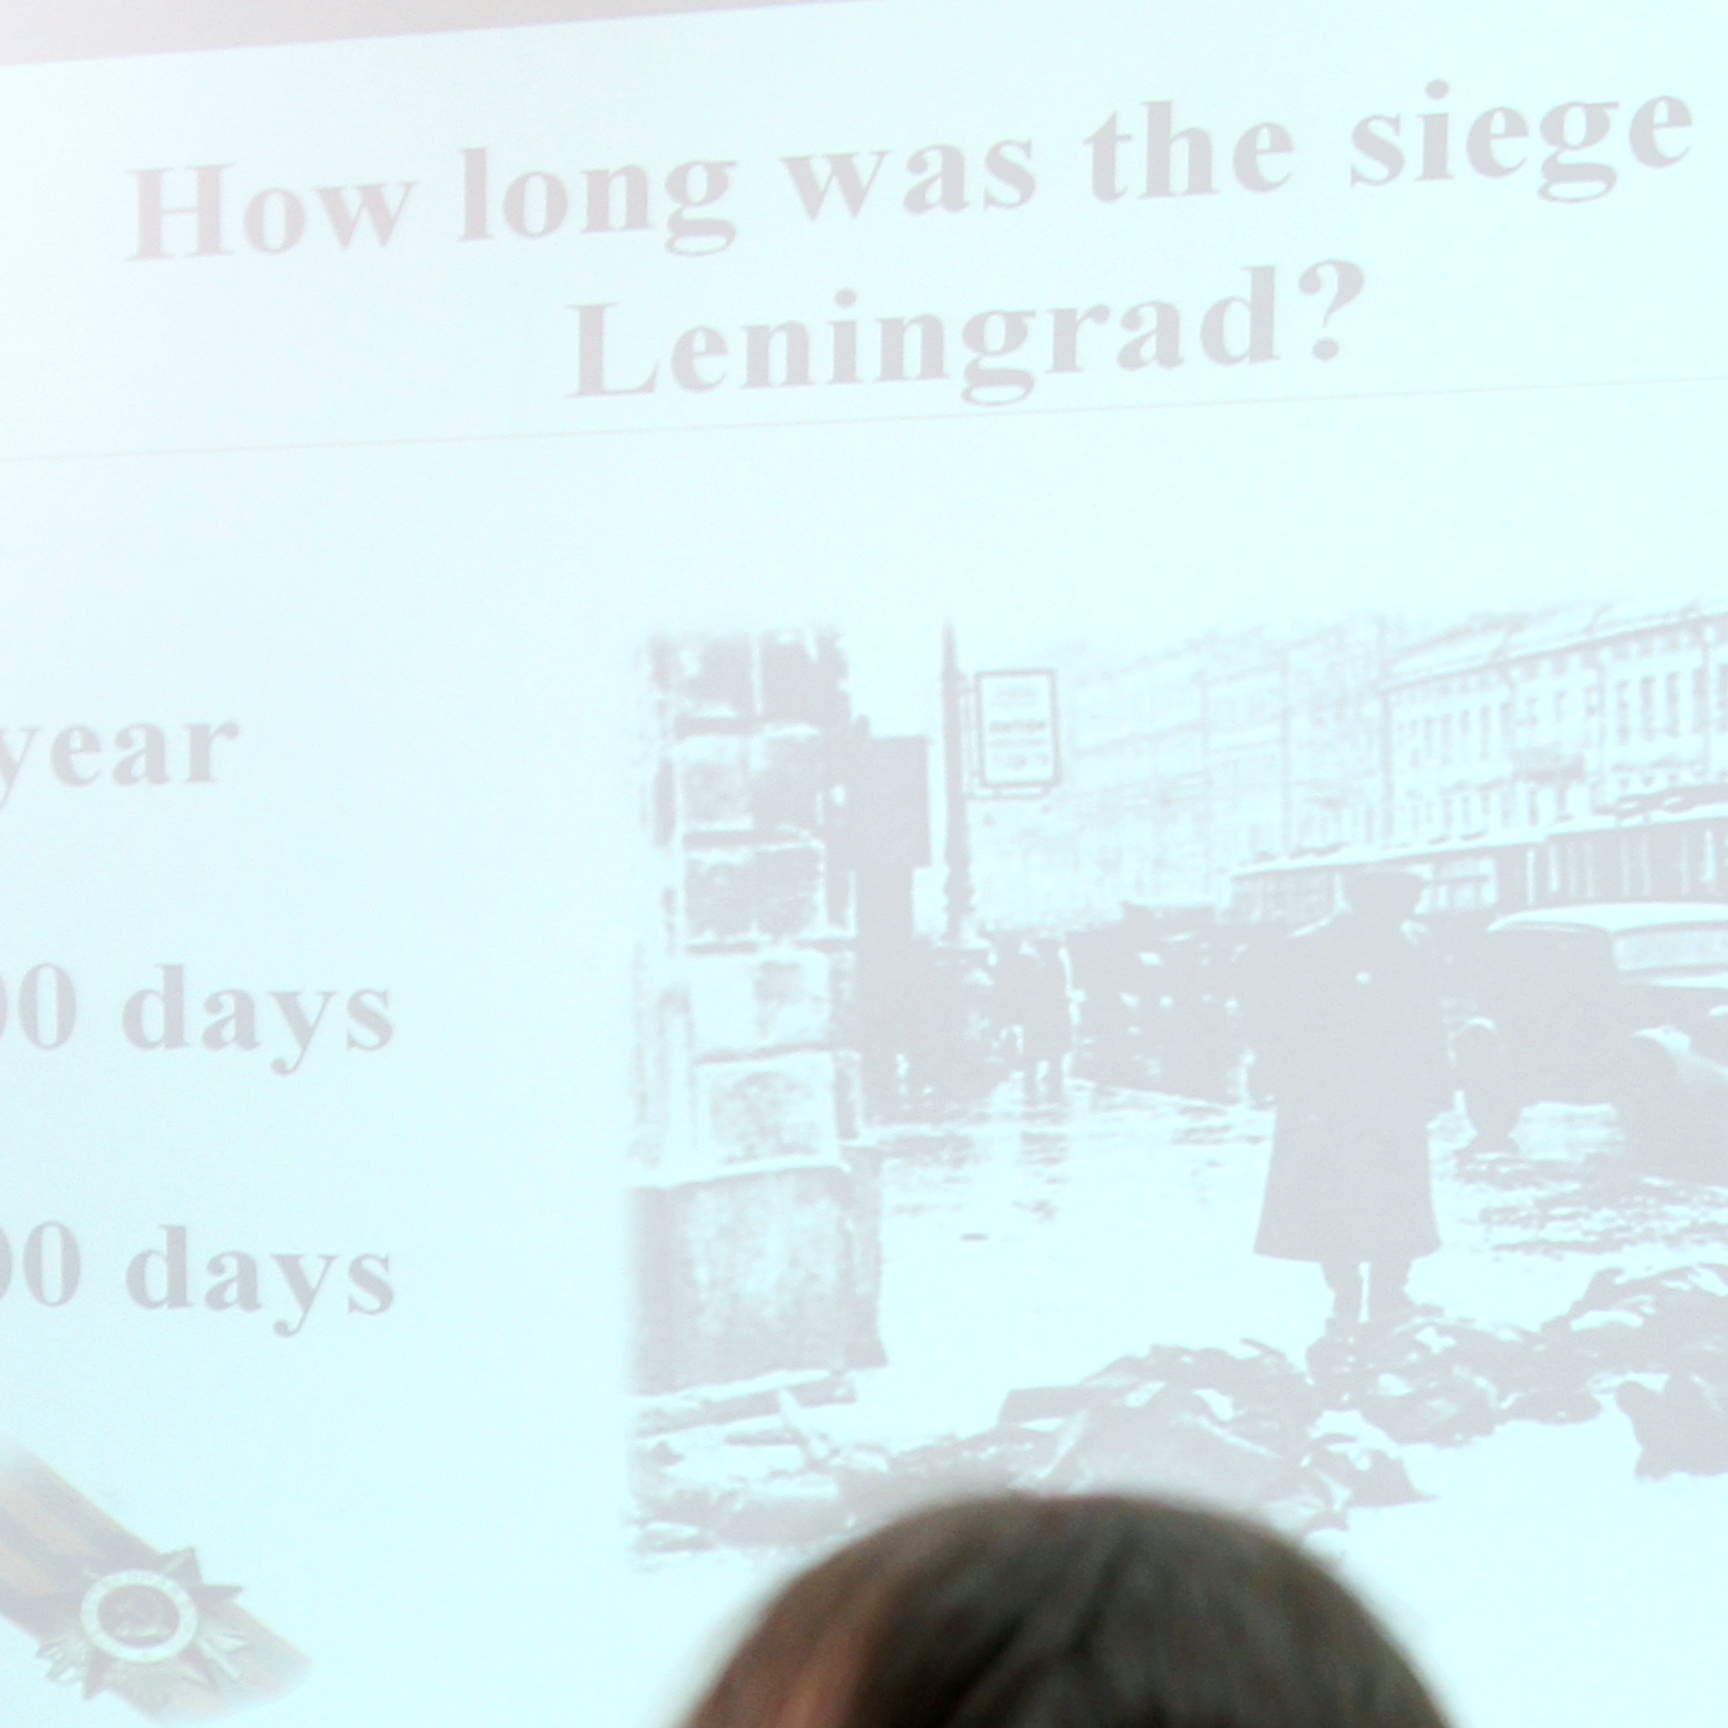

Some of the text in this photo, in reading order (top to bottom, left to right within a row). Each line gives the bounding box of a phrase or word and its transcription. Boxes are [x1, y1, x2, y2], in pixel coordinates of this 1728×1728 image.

[125, 162, 417, 262] How
[458, 147, 738, 257] long
[781, 138, 1039, 223] was
[1082, 100, 1295, 203] the
[1349, 79, 1693, 203] siege
[565, 259, 1366, 408] Leningrad?
[121, 963, 395, 1077] days
[125, 1223, 396, 1338] days
